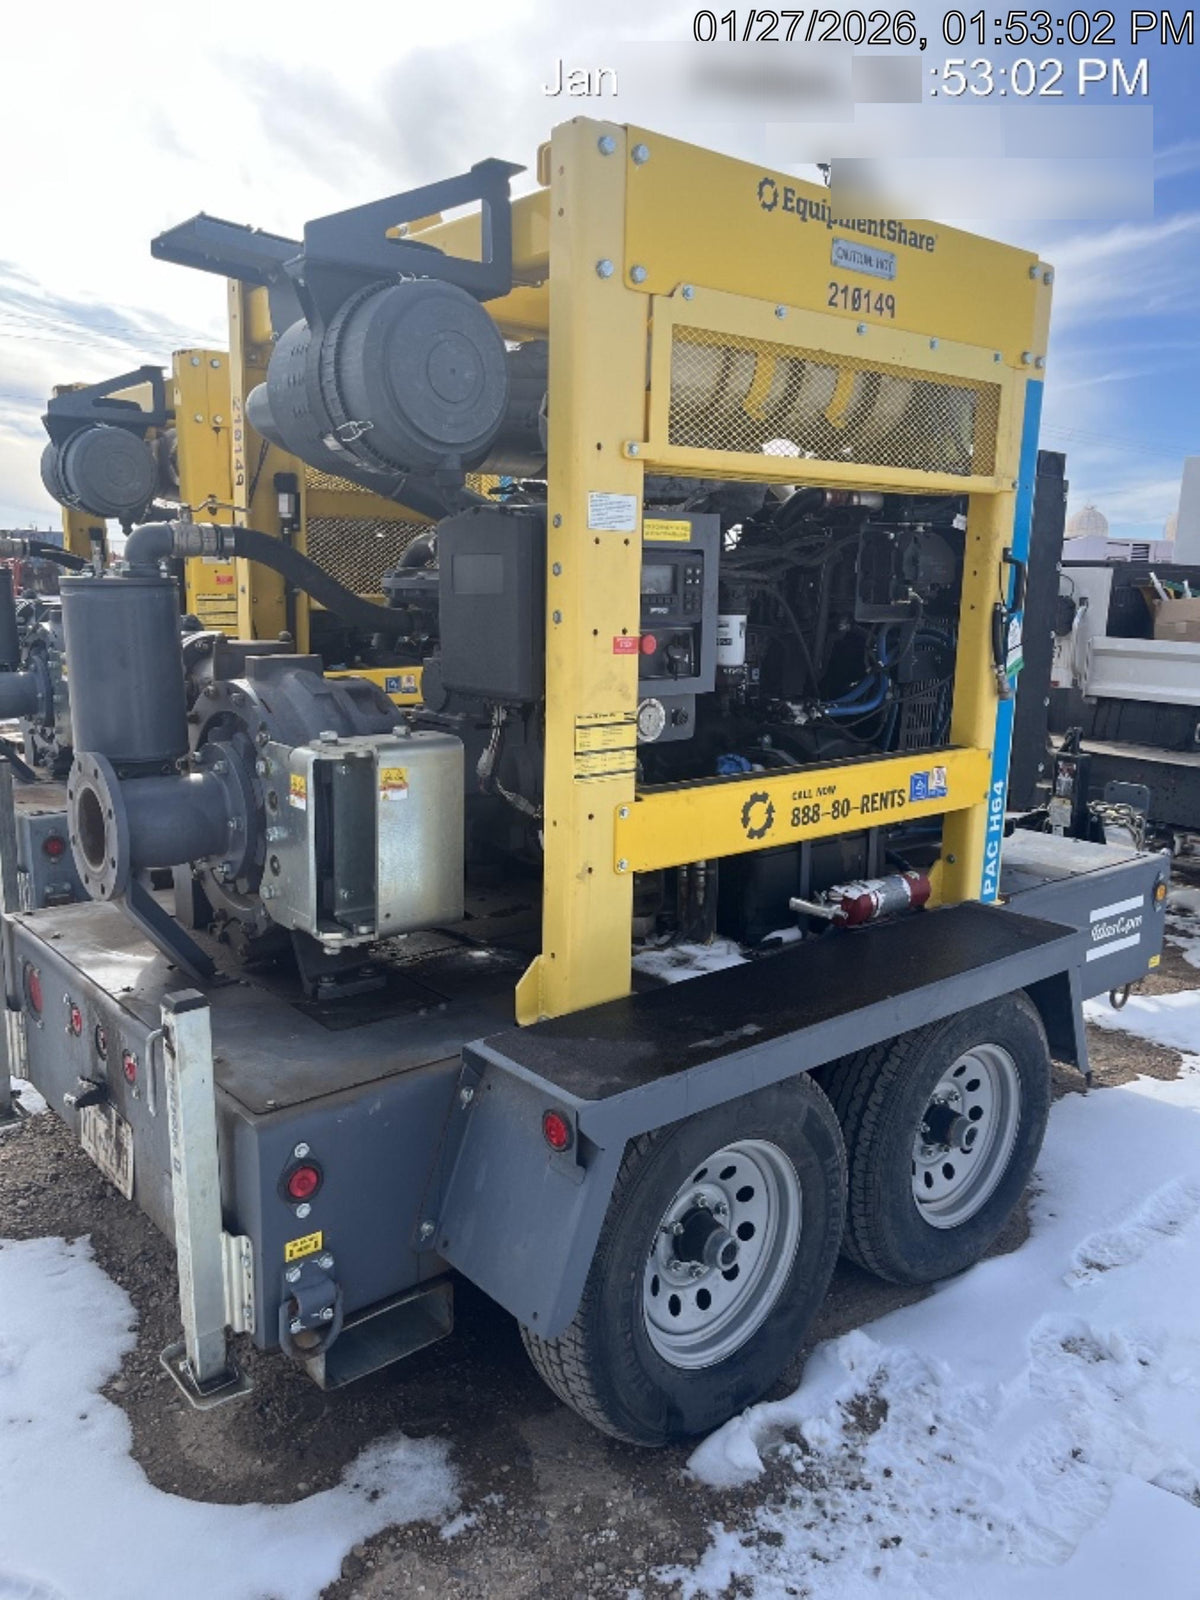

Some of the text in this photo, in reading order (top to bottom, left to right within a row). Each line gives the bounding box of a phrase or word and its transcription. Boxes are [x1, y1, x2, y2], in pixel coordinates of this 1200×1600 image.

[827, 281, 896, 319] 210149
[791, 789, 906, 828] 888-80-RENTS
[792, 785, 837, 801] CALL NOW
[983, 779, 1005, 896] PAC H64
